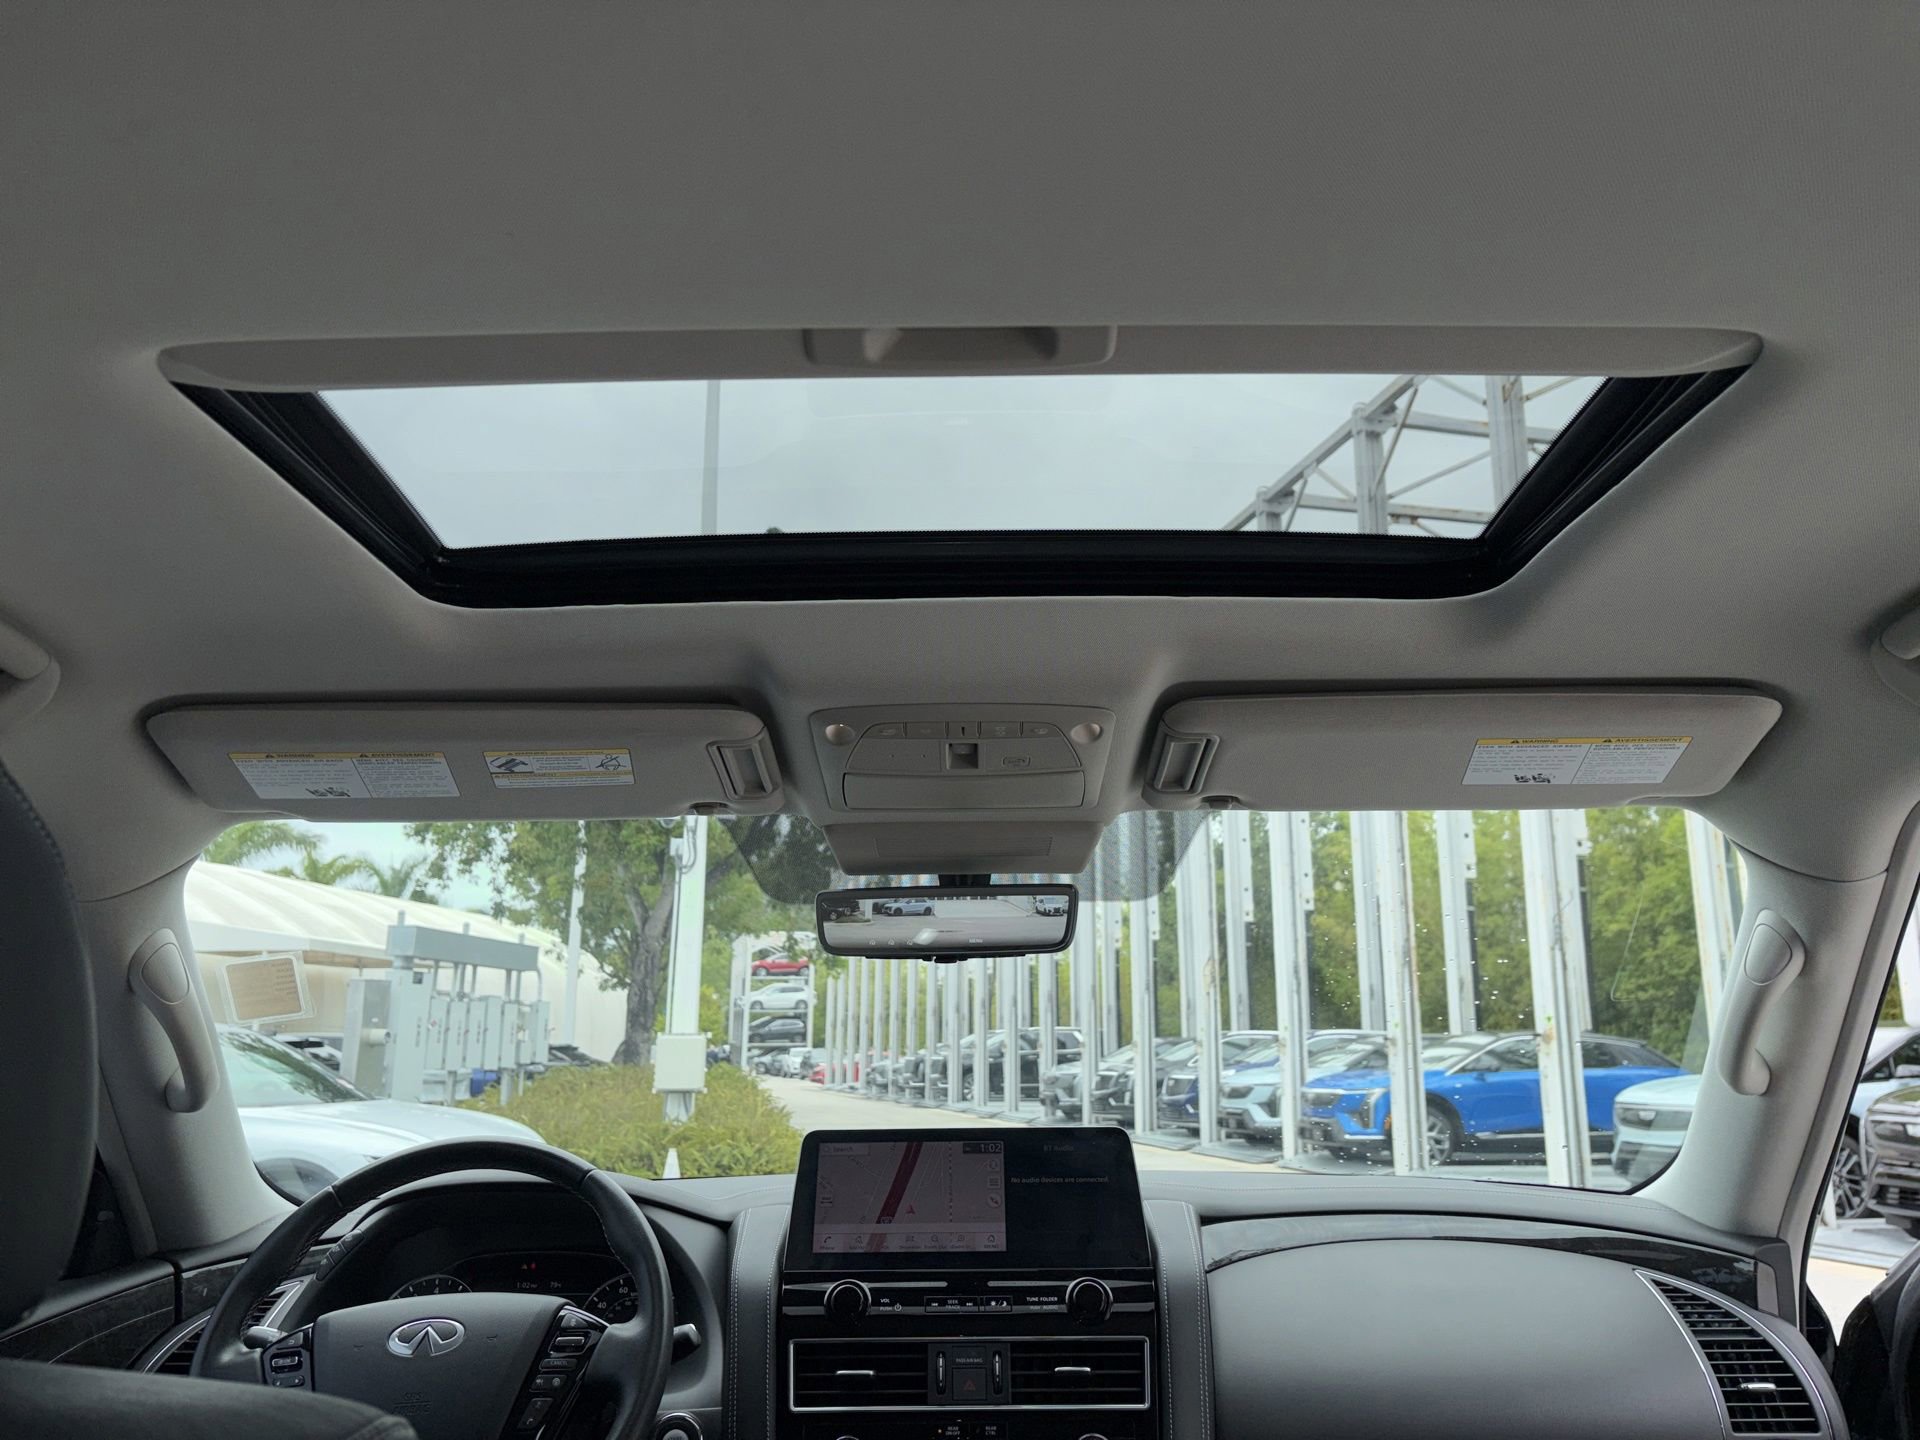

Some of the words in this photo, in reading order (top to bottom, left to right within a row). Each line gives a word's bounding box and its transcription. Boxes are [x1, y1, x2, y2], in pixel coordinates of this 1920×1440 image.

[980, 1143, 1001, 1153] 1:02
[1021, 1176, 1040, 1184] audio
[1040, 1176, 1063, 1184] devices
[618, 1286, 629, 1294] 60
[597, 1301, 607, 1309] 40
